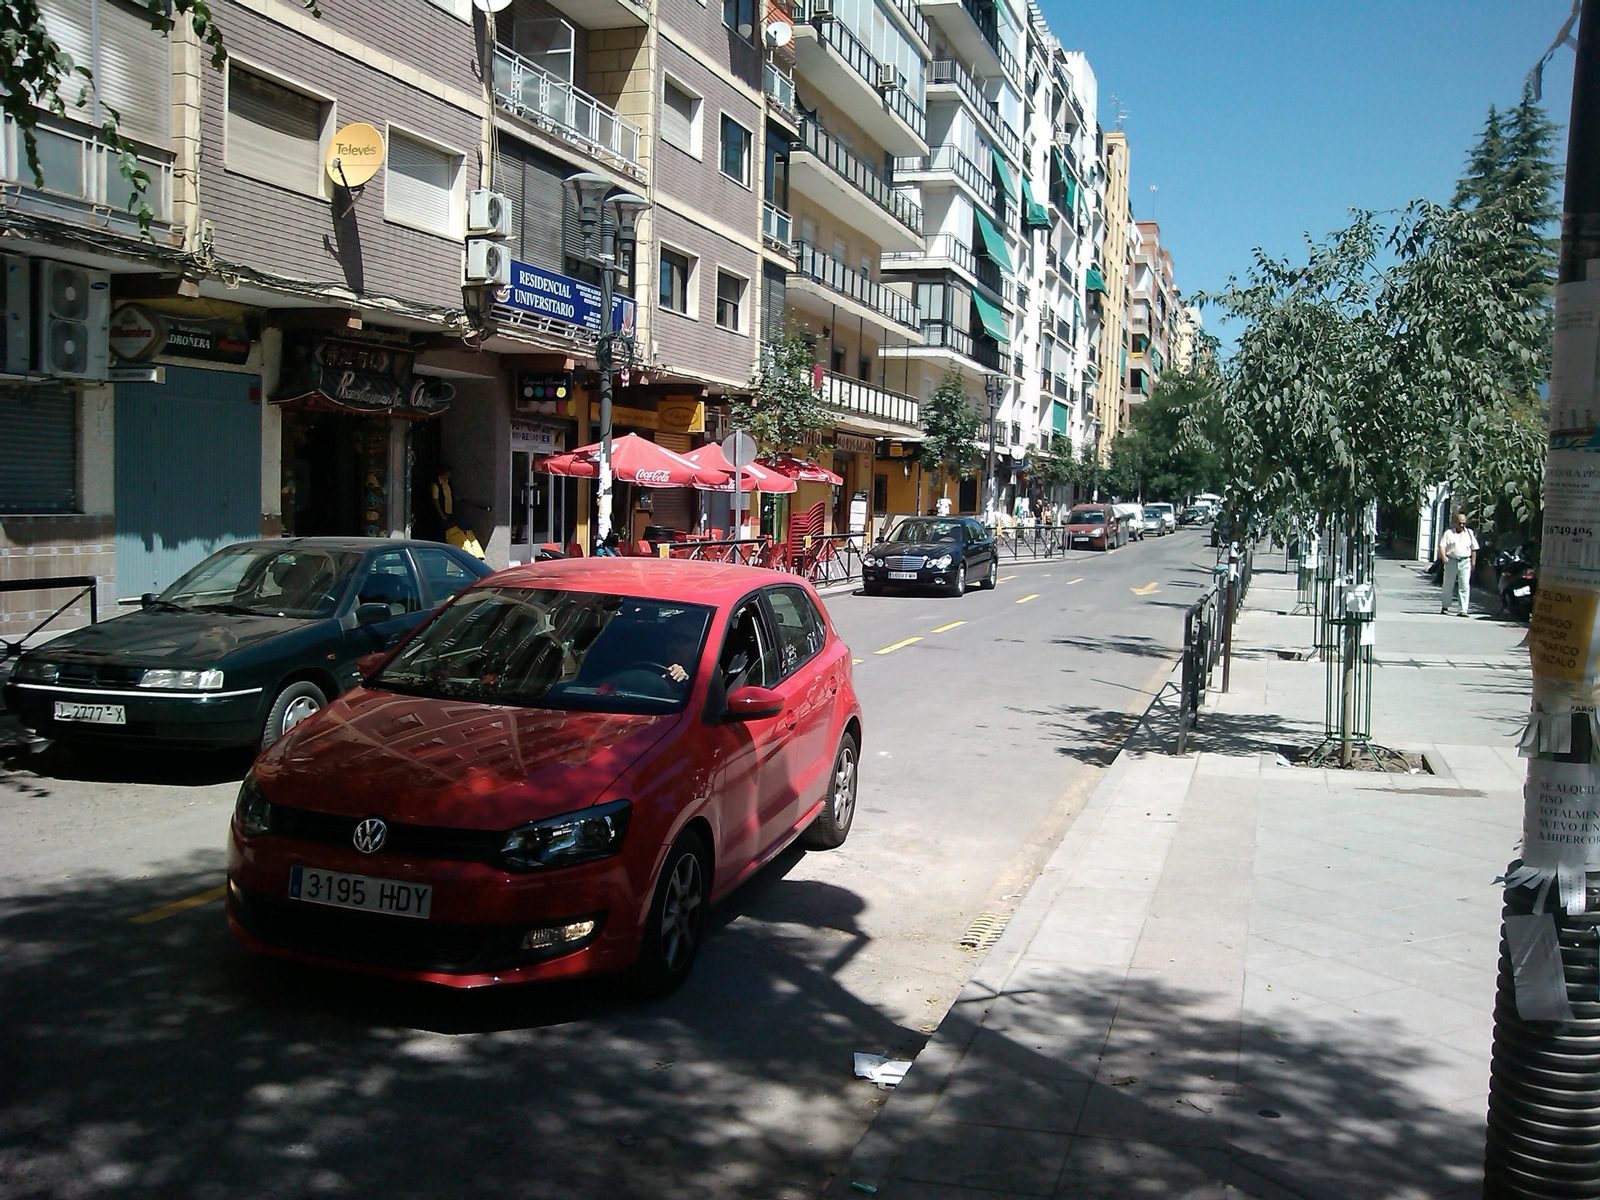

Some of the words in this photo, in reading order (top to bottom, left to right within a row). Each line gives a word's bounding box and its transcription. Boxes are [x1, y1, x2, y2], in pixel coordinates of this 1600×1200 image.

[335, 142, 376, 156] Televés
[519, 270, 572, 299] RESIDENCIAL
[514, 288, 575, 318] UNIVERSITARIO
[1555, 592, 1572, 604] DIA
[1547, 629, 1567, 641] POR
[1540, 781, 1552, 792] SE
[1540, 793, 1563, 805] PISO
[1539, 818, 1578, 831] NUEVO
[1537, 831, 1545, 840] A
[307, 873, 366, 906] 3195
[379, 883, 428, 914] HDY
